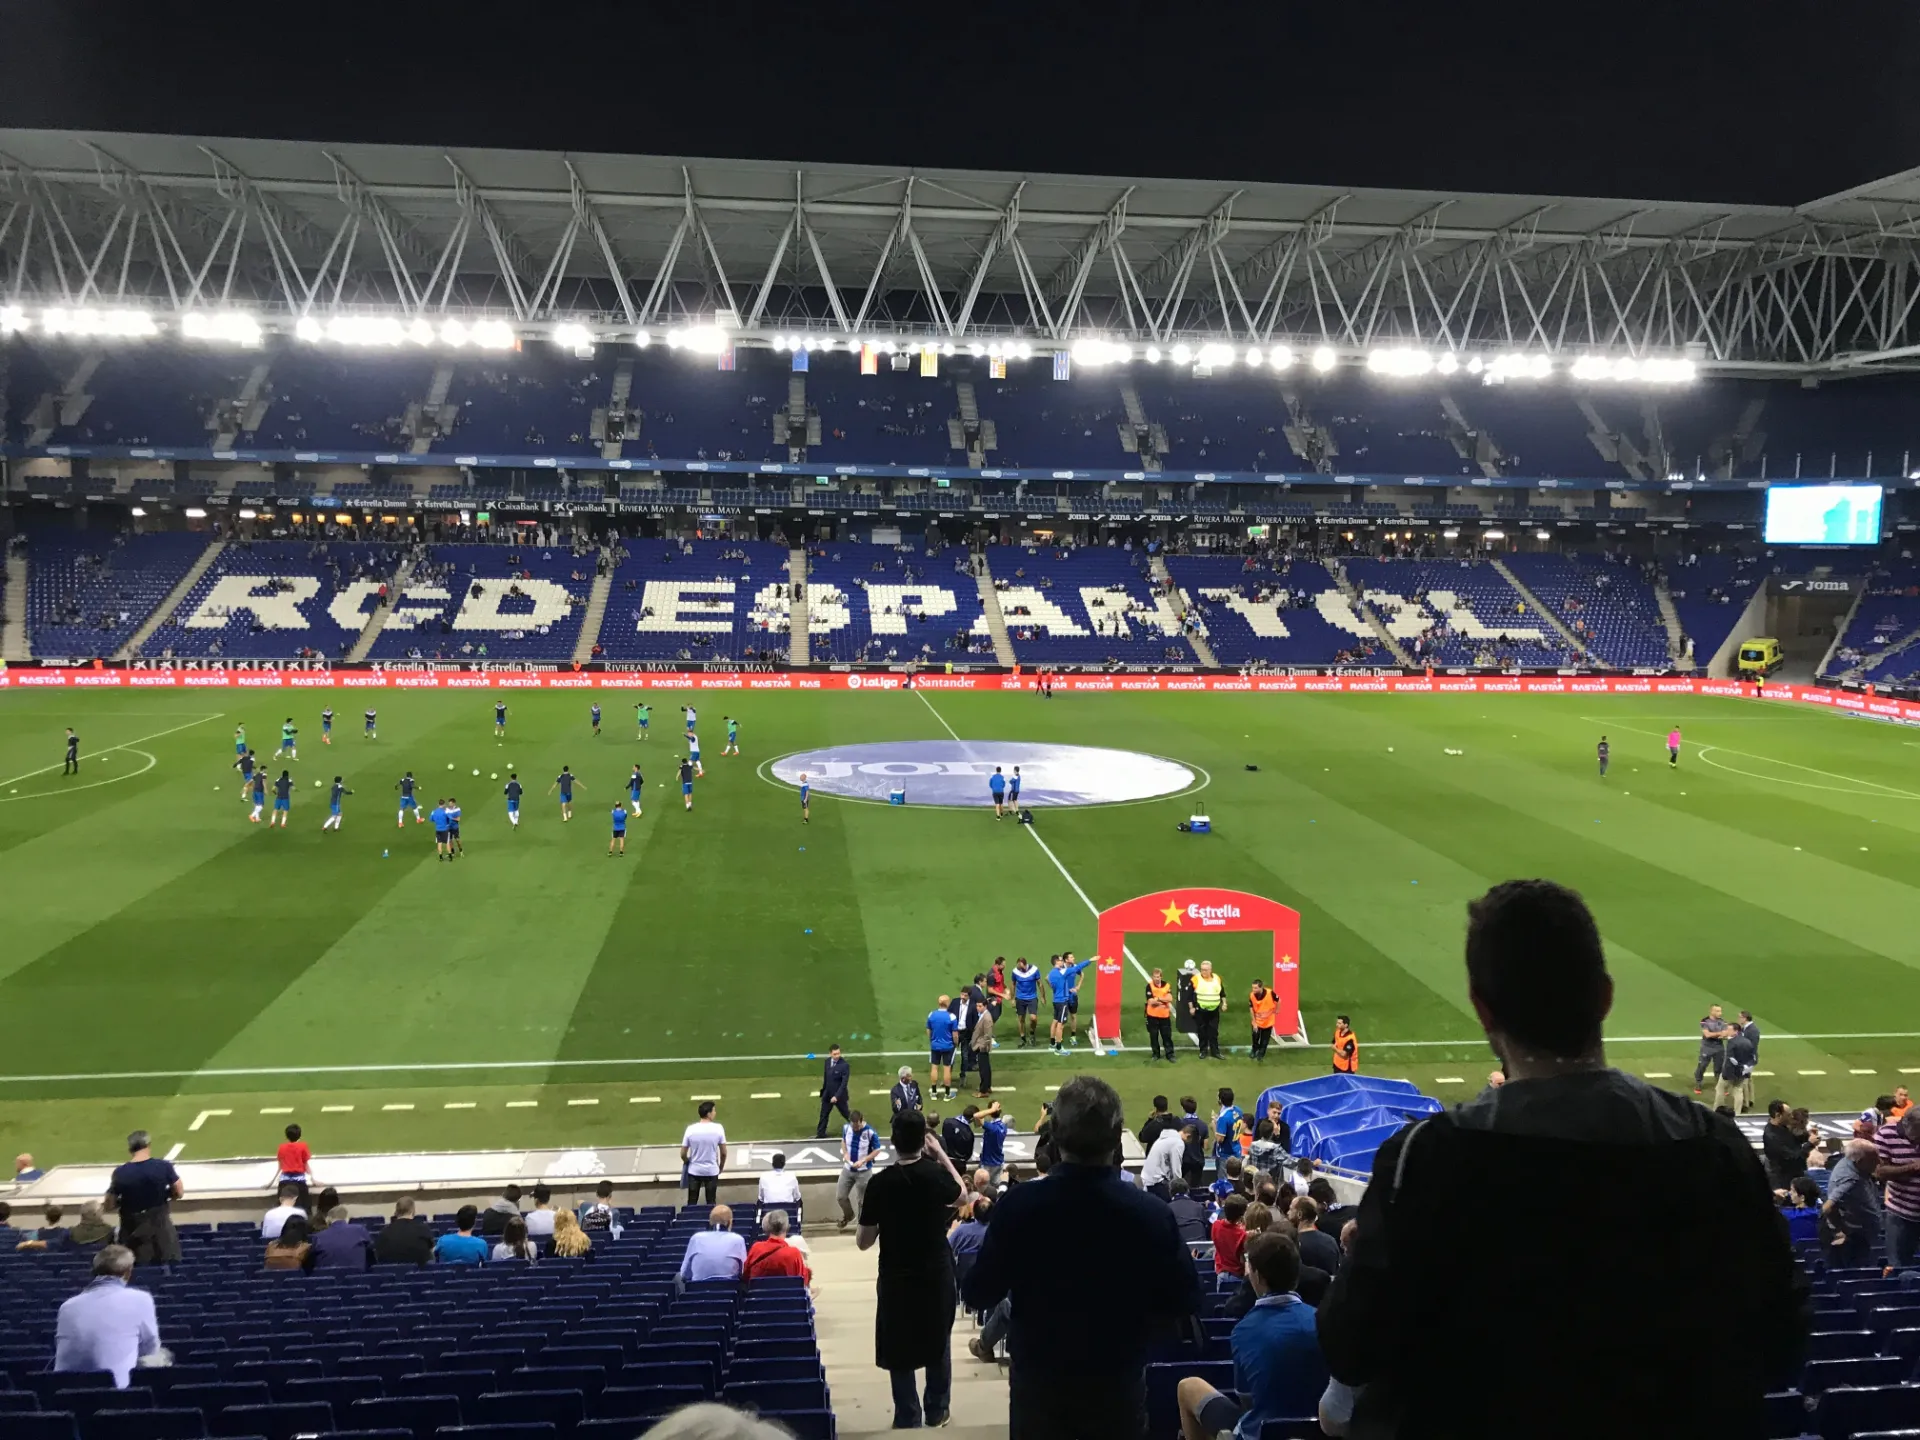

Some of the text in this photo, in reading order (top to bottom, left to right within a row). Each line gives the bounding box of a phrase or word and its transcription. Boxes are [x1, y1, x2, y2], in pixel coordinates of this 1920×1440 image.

[353, 499, 407, 508] Estrella Damm
[424, 500, 476, 509] Estrella Damm
[498, 501, 539, 511] CaixaBank
[566, 503, 607, 512] CaixaBank
[384, 662, 460, 672] Estrella Damm
[482, 662, 558, 673] Estrella Damm
[605, 663, 677, 673] RIVIERA MAYA
[703, 663, 774, 673] RIVIERA MAYA
[1250, 667, 1317, 677] Estrella Damm
[1336, 667, 1403, 677] Estrella Damm
[19, 676, 65, 685] RASTAR
[75, 676, 120, 685] RASTAR
[130, 677, 175, 686] RASTAR
[184, 677, 229, 686] RASTAR
[238, 677, 282, 686] RASTAR
[291, 678, 334, 686] RASTAR
[344, 678, 386, 686] RASTAR
[396, 678, 438, 686] RASTAR
[448, 678, 490, 687] RASTAR
[499, 679, 541, 687] RASTAR
[550, 679, 592, 687] RASTAR
[601, 679, 643, 687] RASTAR
[652, 679, 692, 687] RASTAR
[701, 680, 742, 688] RASTAR
[751, 680, 791, 688] RASTAR
[863, 677, 976, 689] LaLiga Santander
[1075, 681, 1113, 689] RASTAR
[1168, 682, 1205, 690] RASTAR
[1213, 682, 1251, 690] RASTAR
[1259, 682, 1297, 690] RASTAR
[1440, 683, 1477, 691] RASTAR
[1484, 683, 1521, 691] RASTAR
[1528, 683, 1564, 691] RASTAR
[1572, 683, 1608, 691] RASTAR
[1615, 683, 1651, 691] RASTAR
[1658, 684, 1693, 692] RASTAR
[1188, 904, 1240, 918] Estrella
[1202, 918, 1226, 926] Damm
